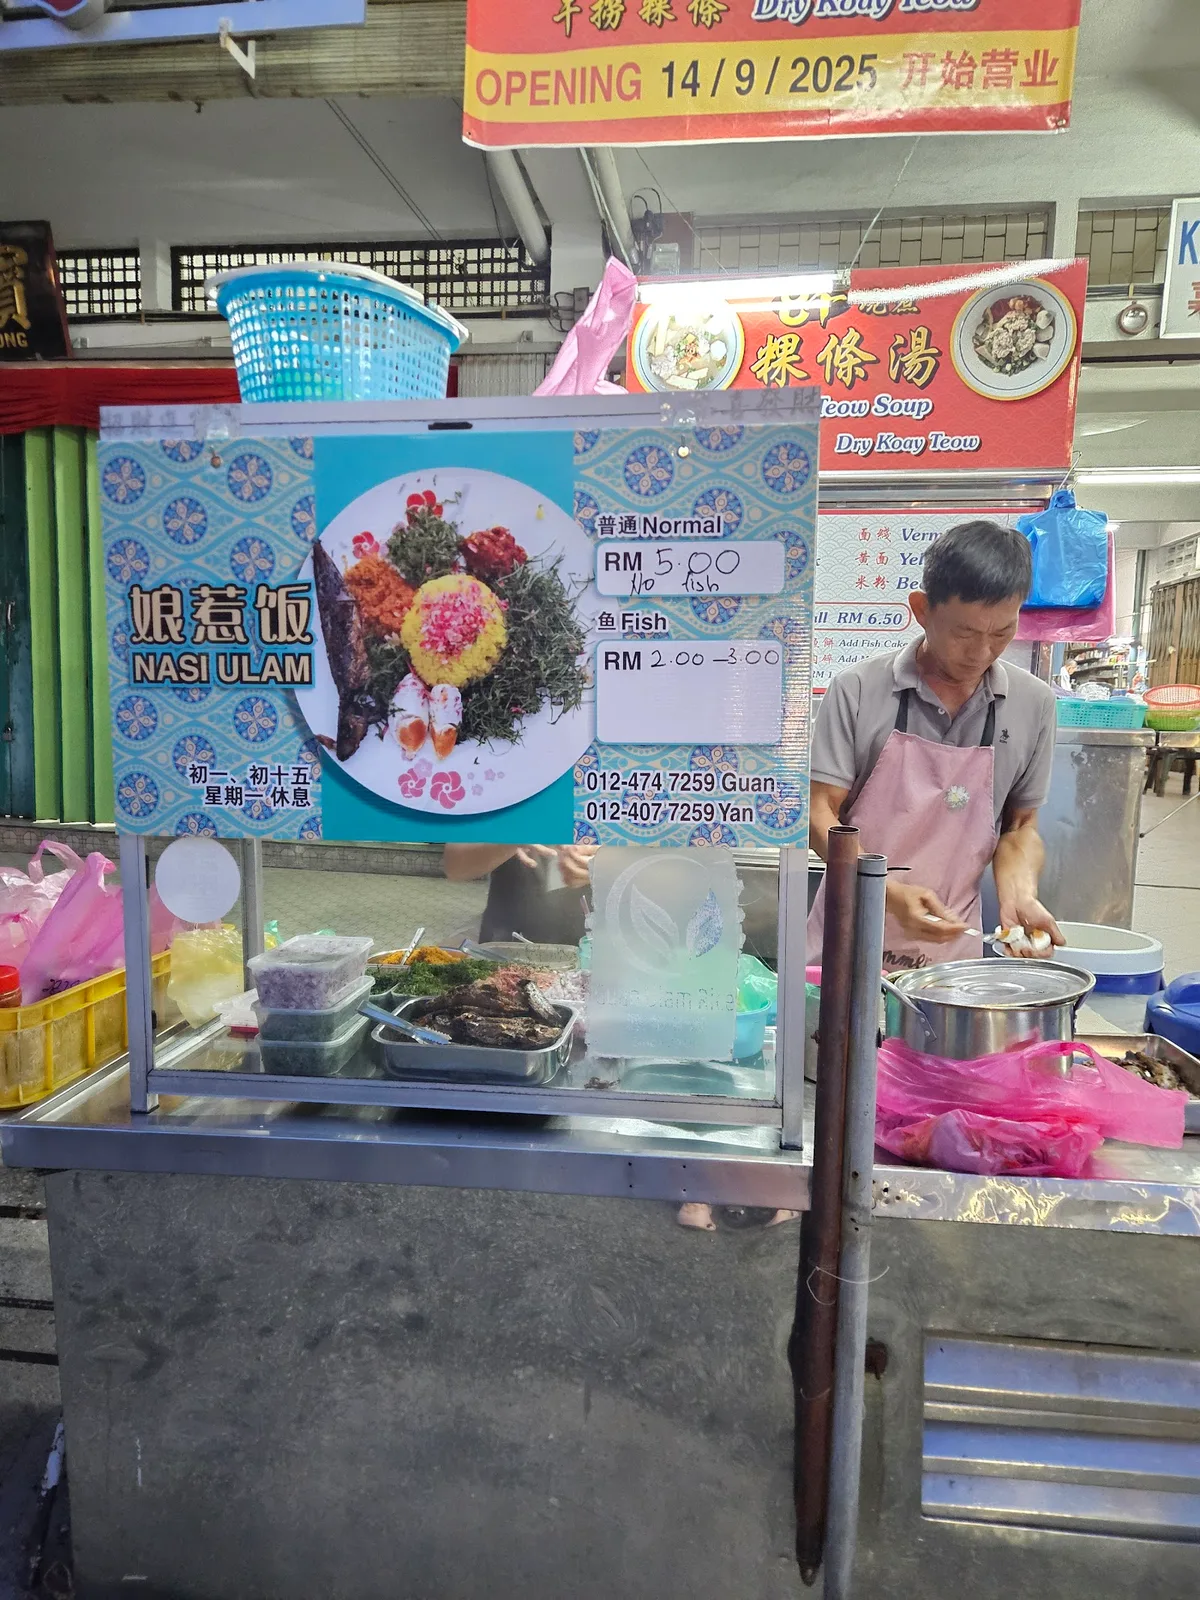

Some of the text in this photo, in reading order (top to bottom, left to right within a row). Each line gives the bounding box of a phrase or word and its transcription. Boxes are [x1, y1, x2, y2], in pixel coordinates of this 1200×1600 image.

[475, 62, 642, 106] OPENING
[789, 54, 878, 94] 2025
[902, 48, 1059, 90] 开始营业
[874, 394, 932, 420] Soup
[836, 432, 982, 454] Dry Koay Teow
[598, 515, 722, 535] 普通 Normal
[604, 548, 740, 575] RM 5.00
[630, 573, 655, 596] No
[855, 574, 889, 590] 米粉
[129, 583, 314, 645] 娘惹饭
[597, 611, 668, 631] 鱼 Fish
[837, 612, 863, 624] RM
[867, 613, 903, 625] 6.50
[838, 639, 858, 648] Add
[860, 639, 881, 648] Fish
[132, 652, 313, 685] NASI ULAM
[604, 652, 641, 670] RM
[837, 655, 858, 663] Add
[189, 764, 311, 785] 初一、初十五
[586, 772, 776, 792] 012-474 7259 Guan
[204, 786, 312, 807] 星期一休息
[586, 801, 753, 822] 012-407 7259 Yan
